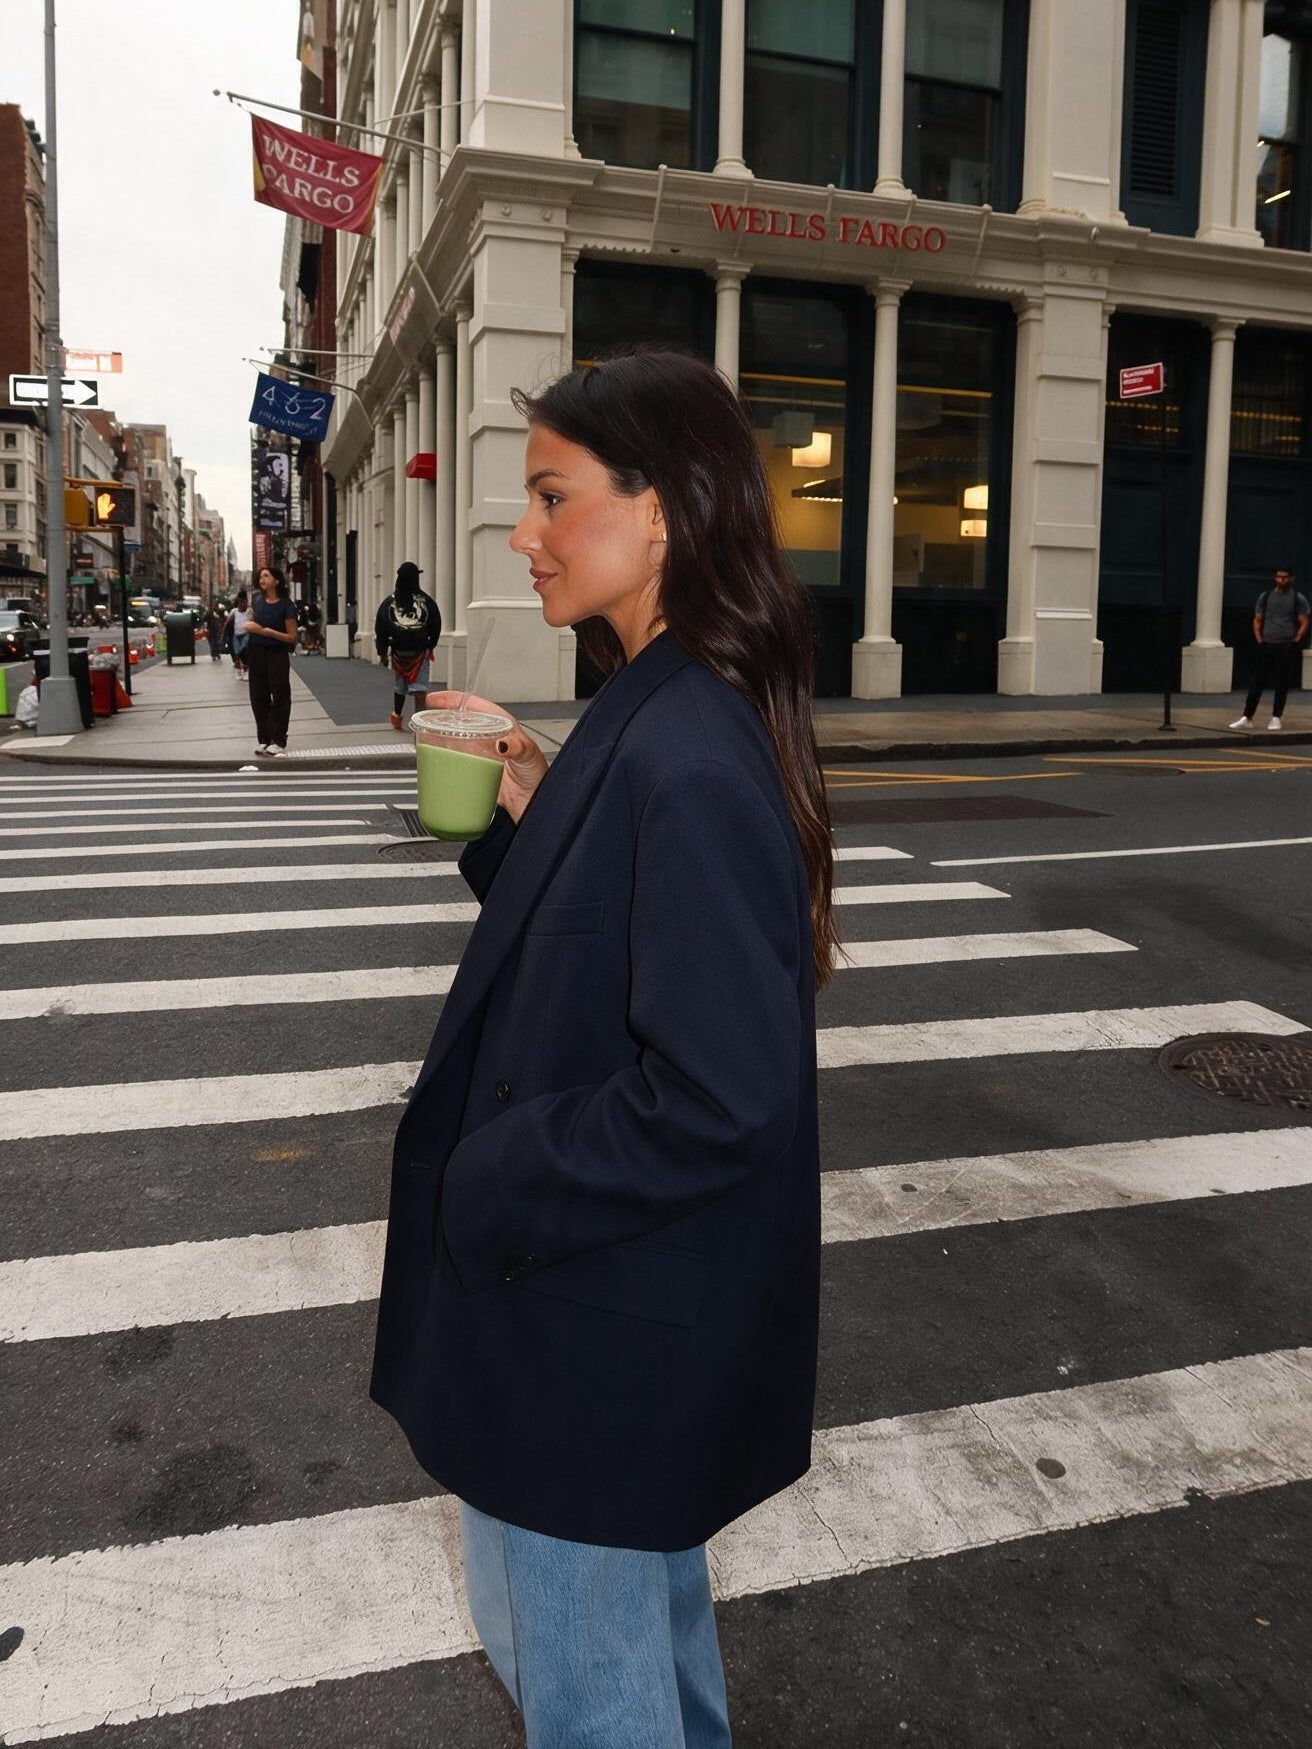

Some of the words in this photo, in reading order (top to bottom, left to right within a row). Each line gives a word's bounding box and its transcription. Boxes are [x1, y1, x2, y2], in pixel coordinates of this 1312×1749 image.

[262, 134, 360, 188] WELLS
[710, 202, 827, 241] WELLS
[838, 216, 946, 254] FARGO
